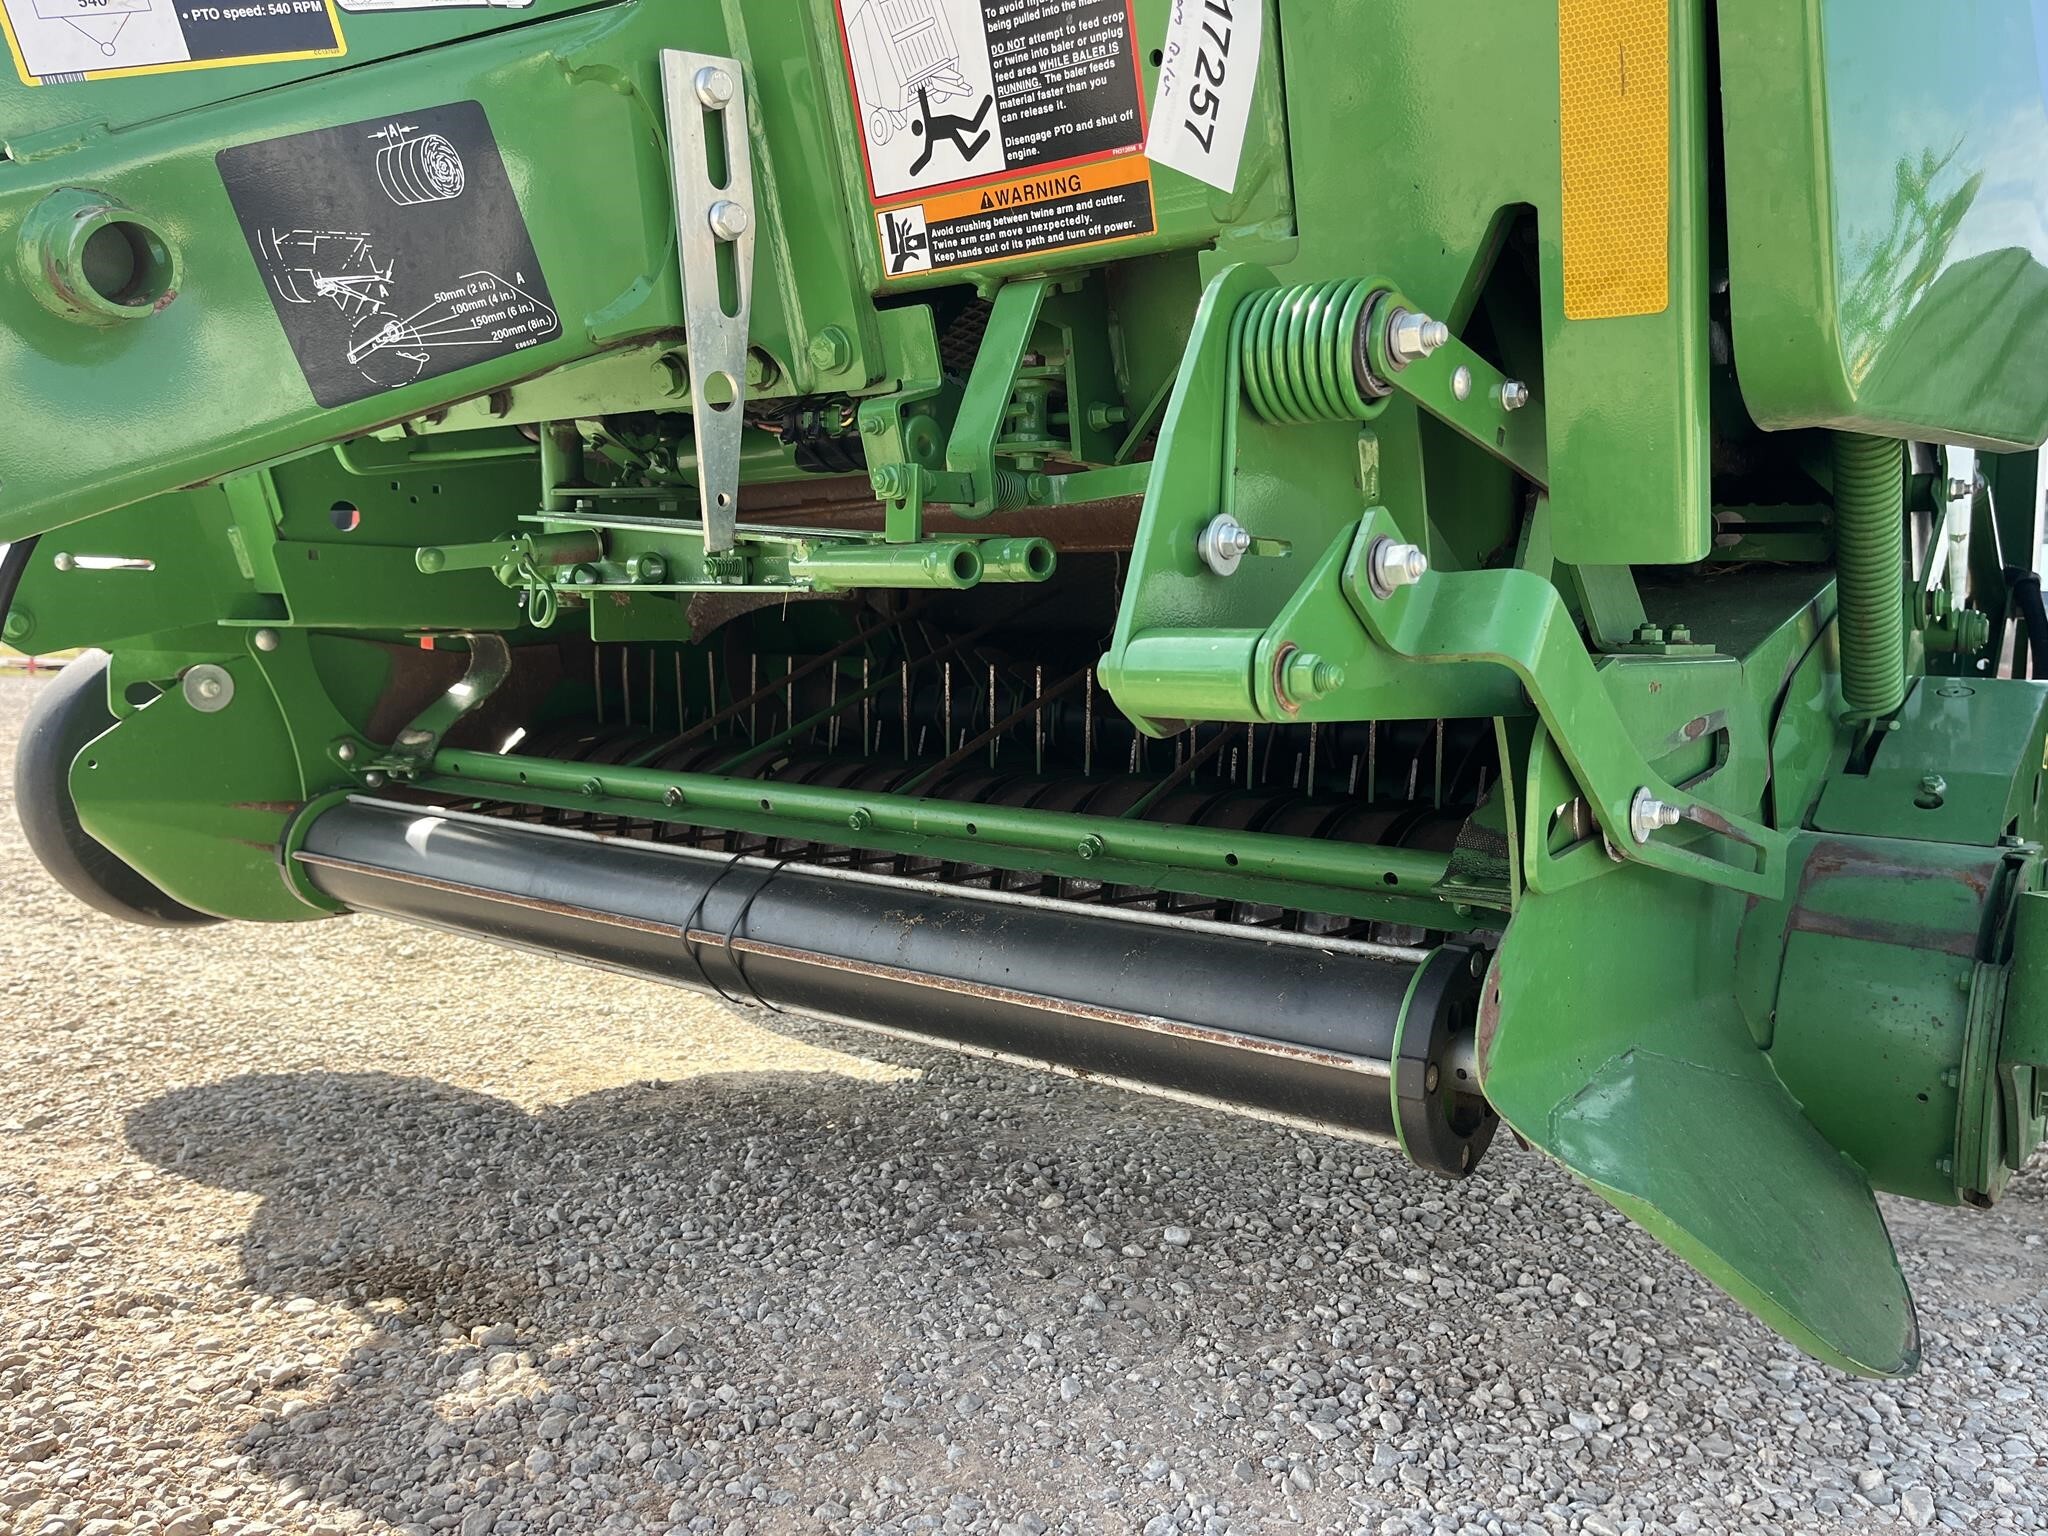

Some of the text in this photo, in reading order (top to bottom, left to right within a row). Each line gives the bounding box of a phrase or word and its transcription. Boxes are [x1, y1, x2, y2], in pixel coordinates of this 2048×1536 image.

[191, 0, 322, 21] PTO speed: 540 RPM
[985, 8, 996, 18] To
[999, 0, 1024, 15] avoid
[988, 18, 1012, 32] being
[1013, 9, 1040, 28] pulled
[1042, 6, 1060, 17] into
[1062, 0, 1076, 12] the
[991, 12, 1124, 55] DO NOT attempt to feed crop
[993, 26, 1123, 69] or twine into baler or unplug
[995, 42, 1119, 82] feed area WHILE BALER IS
[998, 60, 1115, 95] RUNNING. The baler feeds
[1184, 0, 1233, 154] 17257
[1000, 77, 1107, 110] material faster than you
[1001, 100, 1067, 123] can release it.
[389, 124, 398, 138] A
[1005, 109, 1133, 147] Disengage PTO and shut off
[1007, 146, 1040, 160] engine.
[995, 174, 1081, 207] WARNING
[931, 194, 1125, 238] Avoid crushing between twine arm and cutter.
[933, 214, 1092, 250] Twine arm can move unexpectedly.
[935, 252, 955, 262] Keep
[957, 248, 982, 258] hands
[984, 243, 999, 253] out
[1000, 240, 1010, 250] of
[1012, 239, 1023, 249] its
[1025, 235, 1045, 248] path
[1048, 231, 1064, 243] and
[1066, 228, 1086, 239] turn
[1088, 224, 1102, 236] off
[1104, 220, 1136, 235] power.
[379, 284, 389, 298] A
[434, 278, 496, 303] 50mm (2 in.)
[516, 272, 525, 284] A
[451, 289, 516, 315] 100mm (4 in.)
[470, 301, 535, 327] 150mm (6 in.)
[491, 324, 527, 341] 200mm
